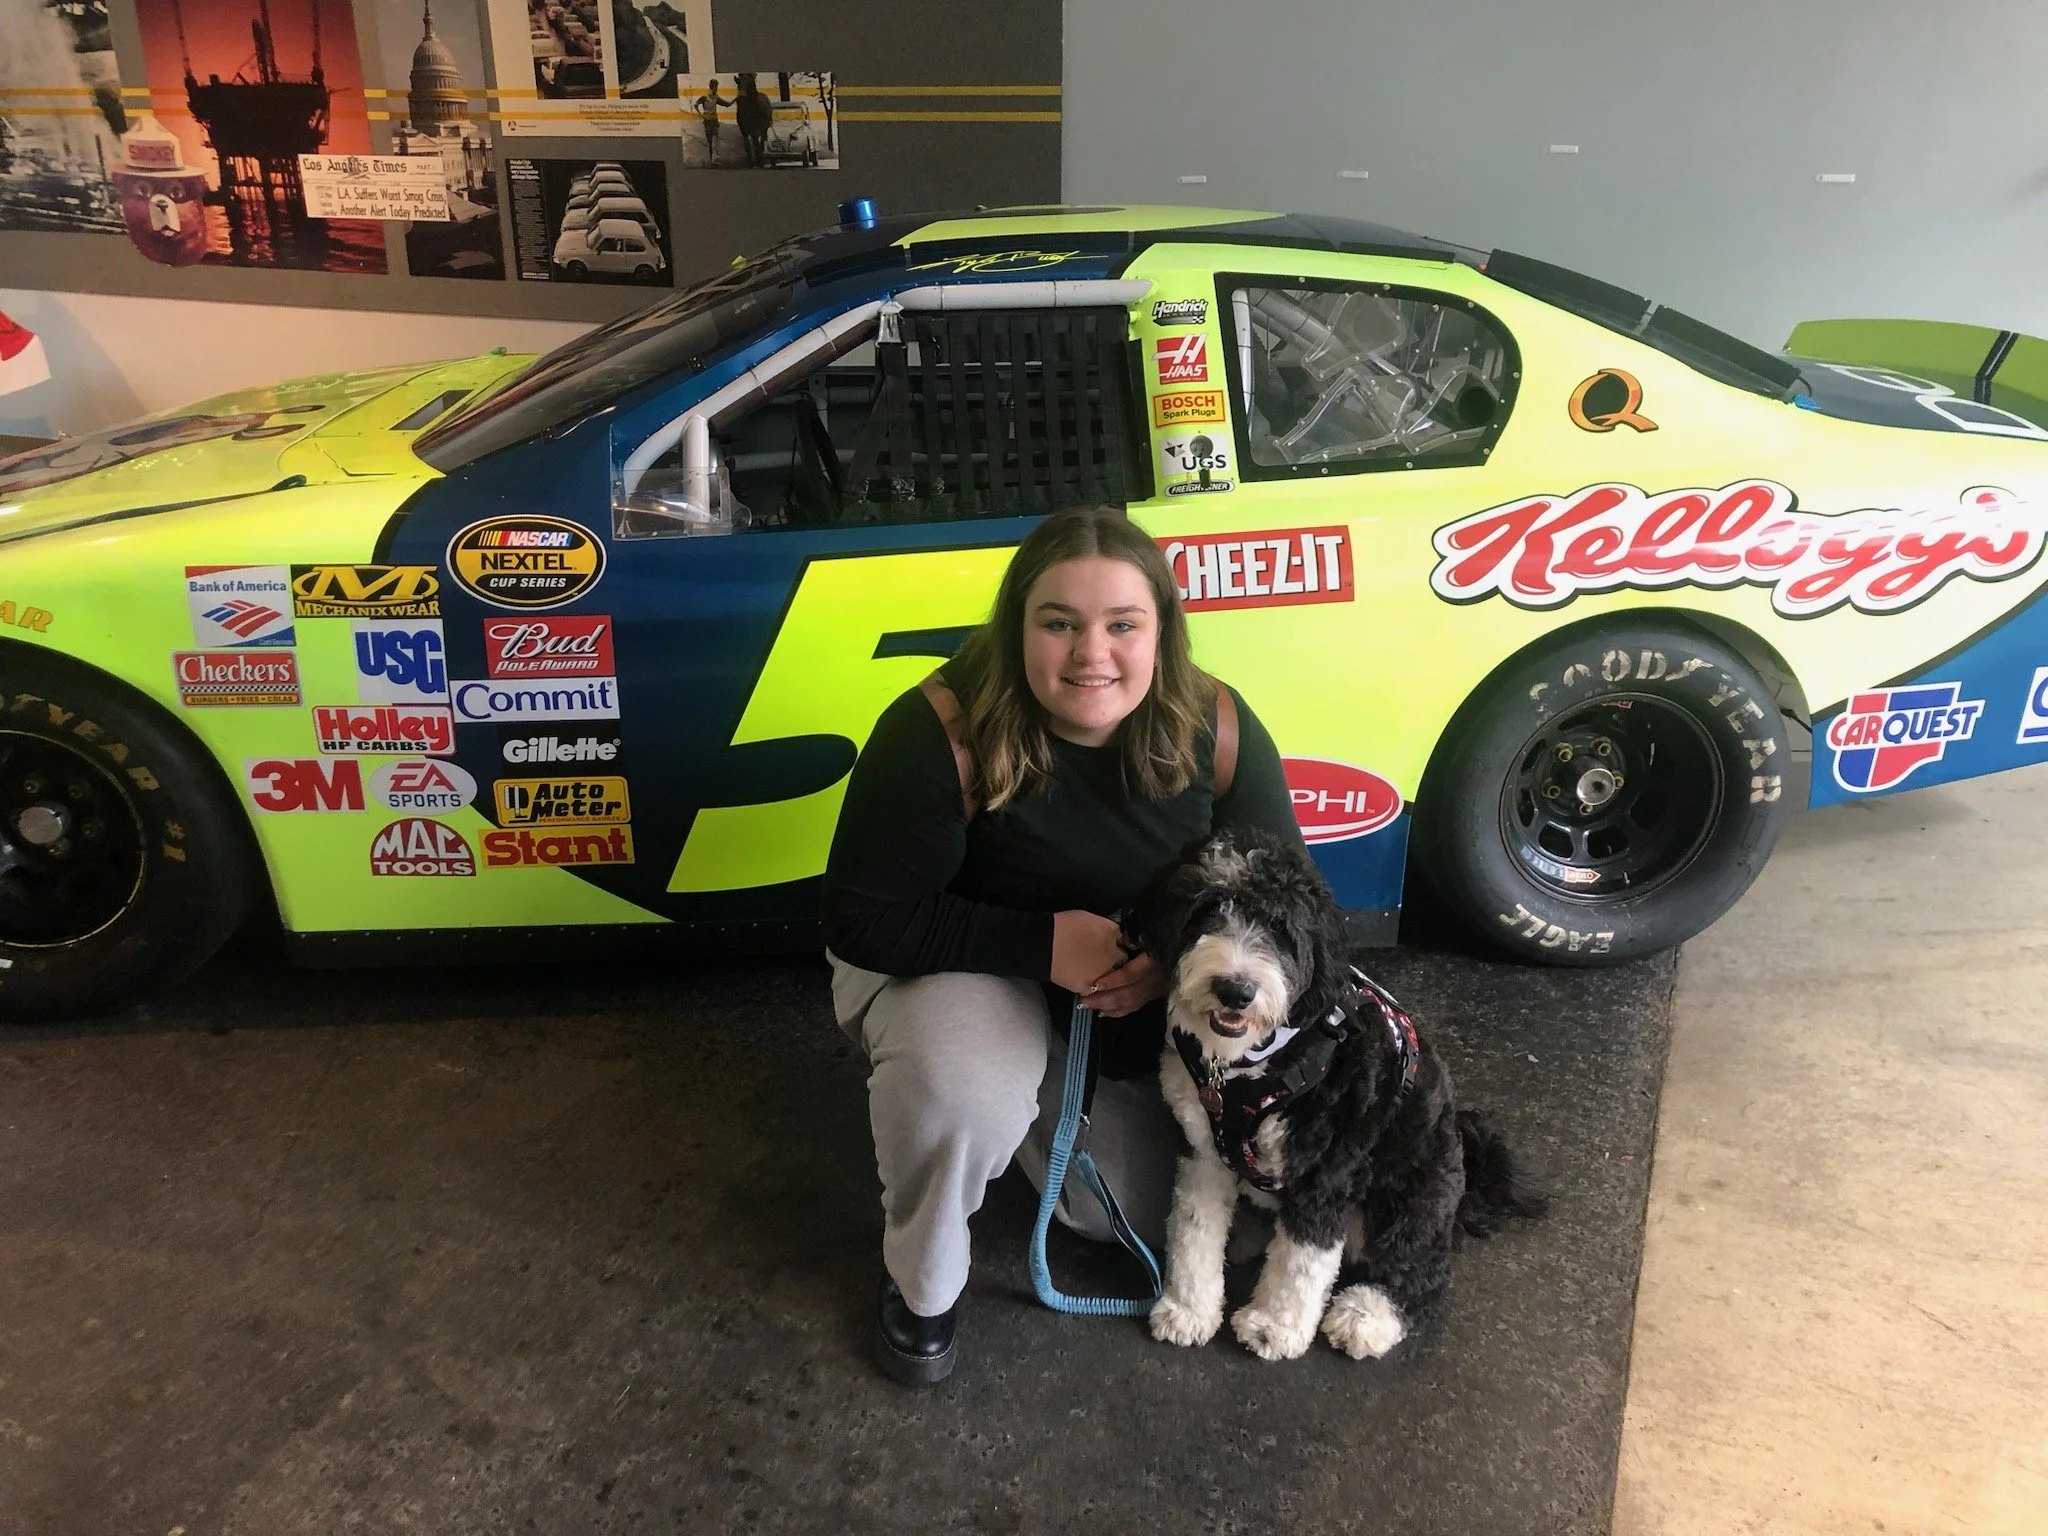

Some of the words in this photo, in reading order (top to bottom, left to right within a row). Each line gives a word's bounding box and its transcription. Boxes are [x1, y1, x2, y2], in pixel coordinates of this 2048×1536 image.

[303, 158, 322, 171] Los
[373, 160, 407, 173] Times
[354, 187, 378, 201] Suffers
[380, 188, 401, 201] Worst
[403, 188, 424, 204] Smog
[340, 204, 367, 216] Another
[370, 204, 387, 217] Alert
[389, 205, 411, 220] Today
[414, 205, 446, 219] Predicted
[1152, 299, 1208, 318] Hendrick
[1159, 364, 1207, 378] HAAS
[1161, 395, 1216, 410] BOSCH
[1568, 368, 1659, 432] Q
[1163, 409, 1190, 420] Spark
[1191, 408, 1216, 417] Plugs
[1182, 454, 1227, 470] UGS
[1171, 482, 1228, 494] FREIGHNER
[507, 531, 570, 547] NASCAR
[480, 552, 573, 570] NEXTEL
[1165, 533, 1344, 600] CHEEZ-IT
[189, 581, 221, 592] Bank
[222, 580, 235, 592] of
[236, 580, 287, 592] America
[489, 577, 517, 588] CUP
[519, 577, 567, 588] SERIES
[295, 601, 388, 616] MECHANIX
[390, 600, 441, 616] WEAR
[488, 622, 606, 659] Bud
[180, 655, 291, 683] Checkers
[354, 629, 446, 694] USG
[456, 680, 613, 720] Commit
[317, 708, 450, 751] Holley
[1830, 705, 1979, 747] CARQUEST
[323, 741, 353, 751] HP
[357, 741, 428, 751] CARBS
[502, 736, 619, 763] Gillette
[251, 759, 366, 812] 3M
[389, 762, 458, 793] EA
[389, 793, 462, 808] SPORTS
[534, 782, 605, 801] Auto
[530, 800, 622, 820] Meter
[1288, 789, 1367, 814] PHI
[373, 820, 470, 859] MAC
[484, 827, 628, 866] Stant
[373, 861, 473, 875] TOOLS
